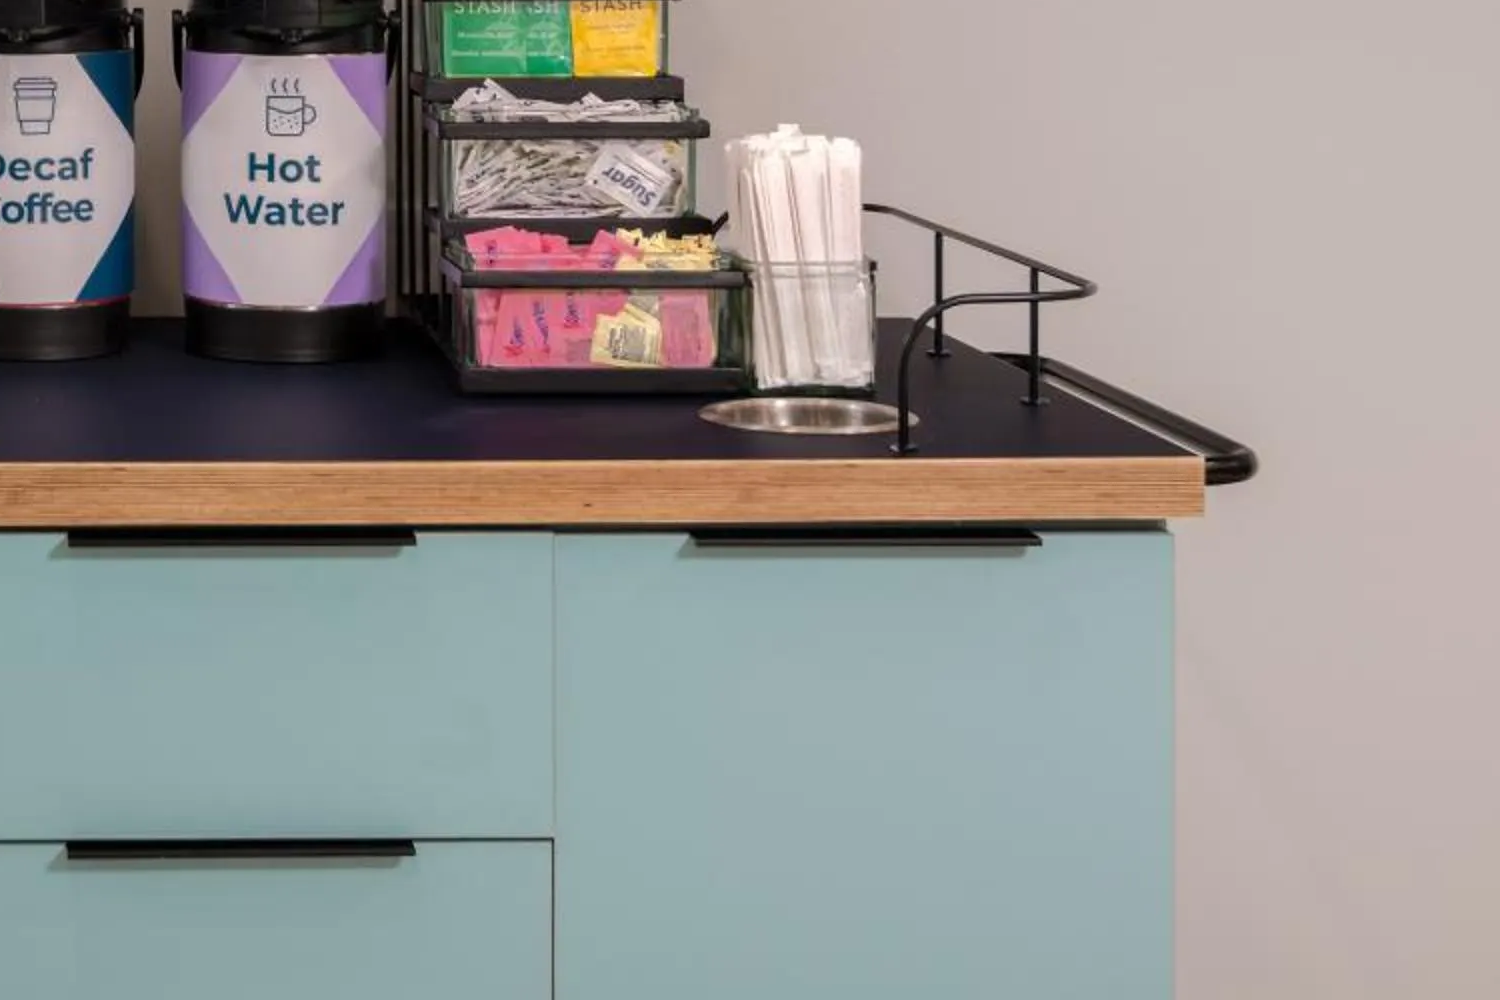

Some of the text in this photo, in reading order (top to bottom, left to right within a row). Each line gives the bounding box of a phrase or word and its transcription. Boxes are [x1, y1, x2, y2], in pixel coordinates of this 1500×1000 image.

[454, 0, 515, 14] STASH
[580, 0, 642, 13] STASH
[248, 151, 322, 183] Hot
[602, 165, 656, 206] Sugar
[223, 192, 345, 226] Water
